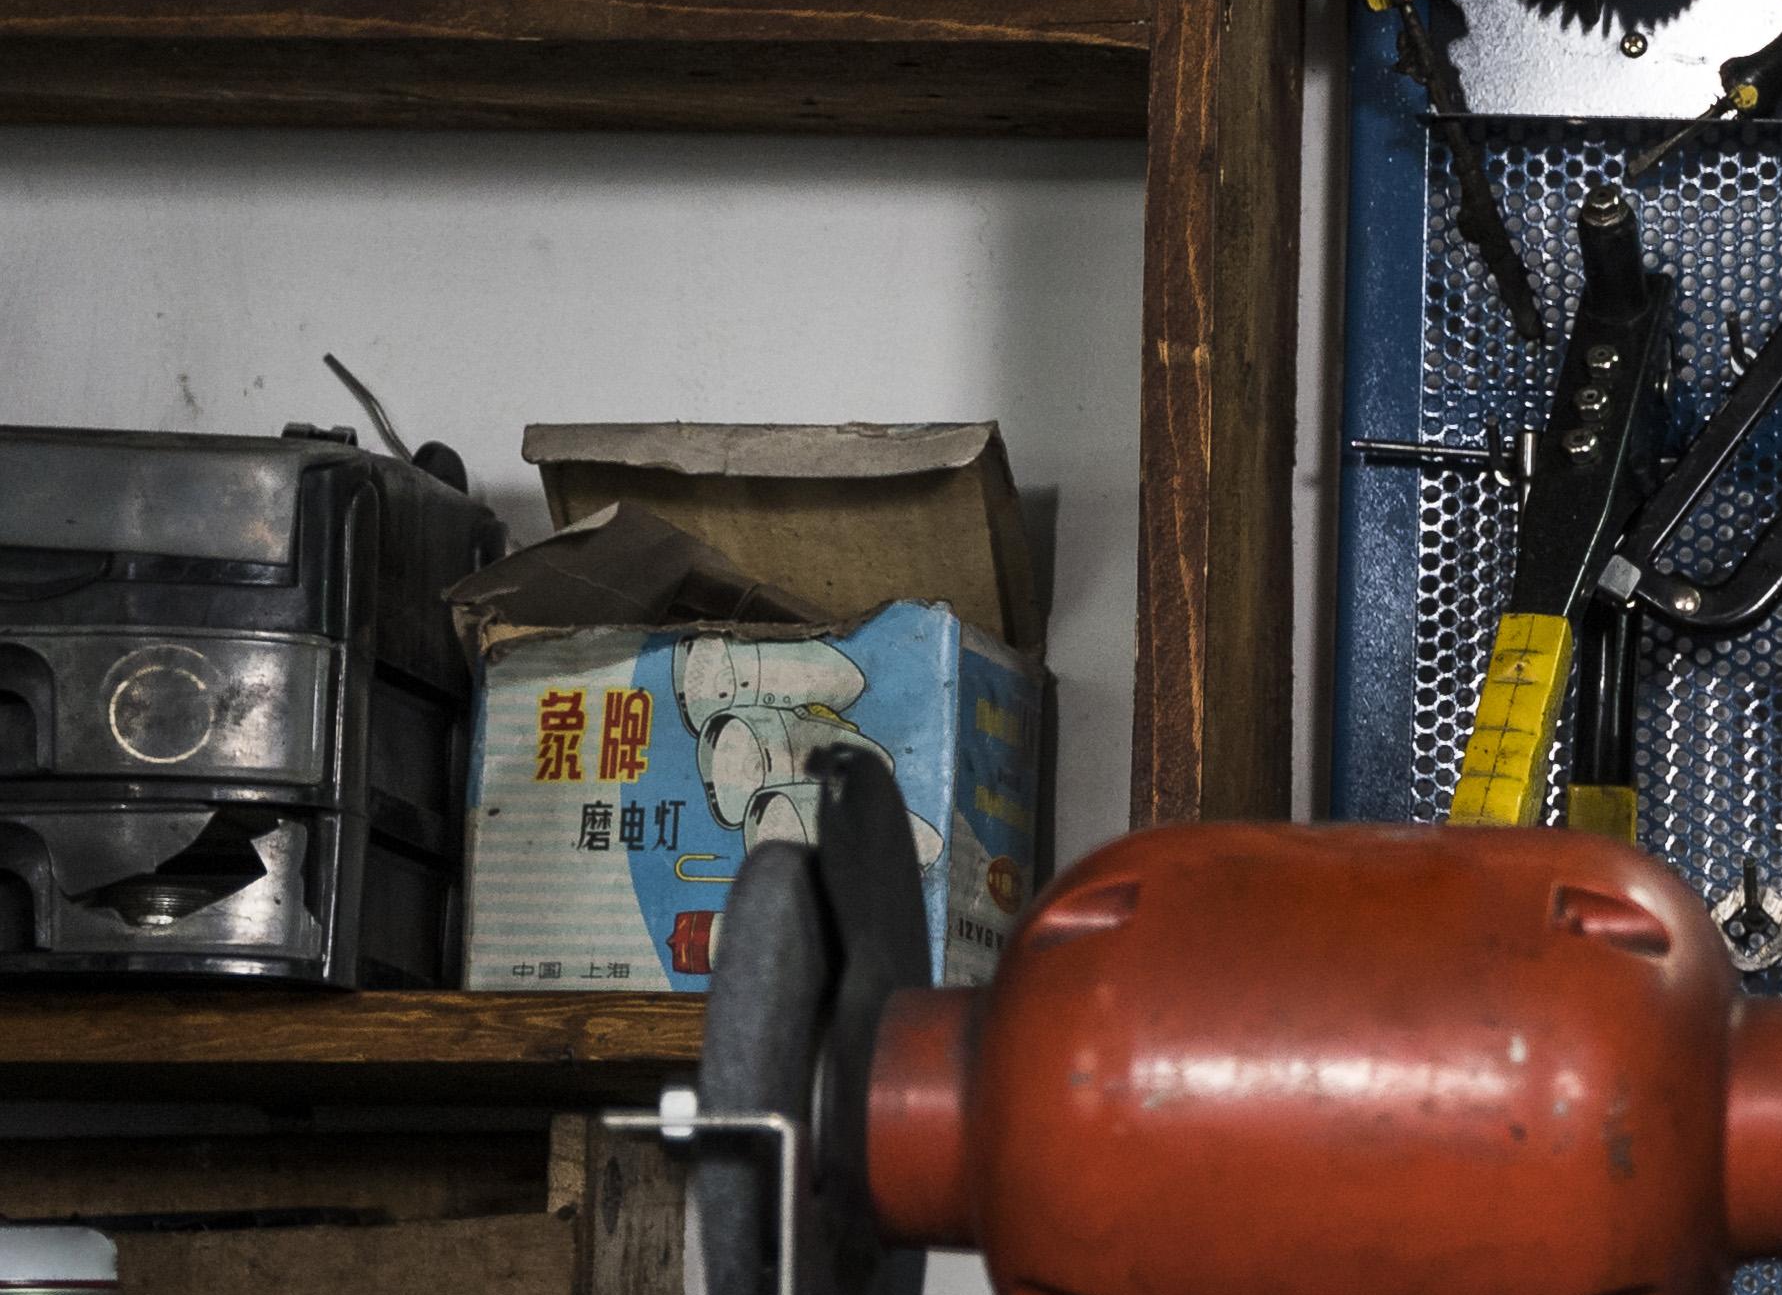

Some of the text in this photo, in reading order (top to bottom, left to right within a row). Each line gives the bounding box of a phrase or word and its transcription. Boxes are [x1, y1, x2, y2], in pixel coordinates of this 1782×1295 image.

[533, 685, 654, 784] 象牌
[577, 799, 687, 851] 磨电灯
[581, 961, 630, 979] 上海
